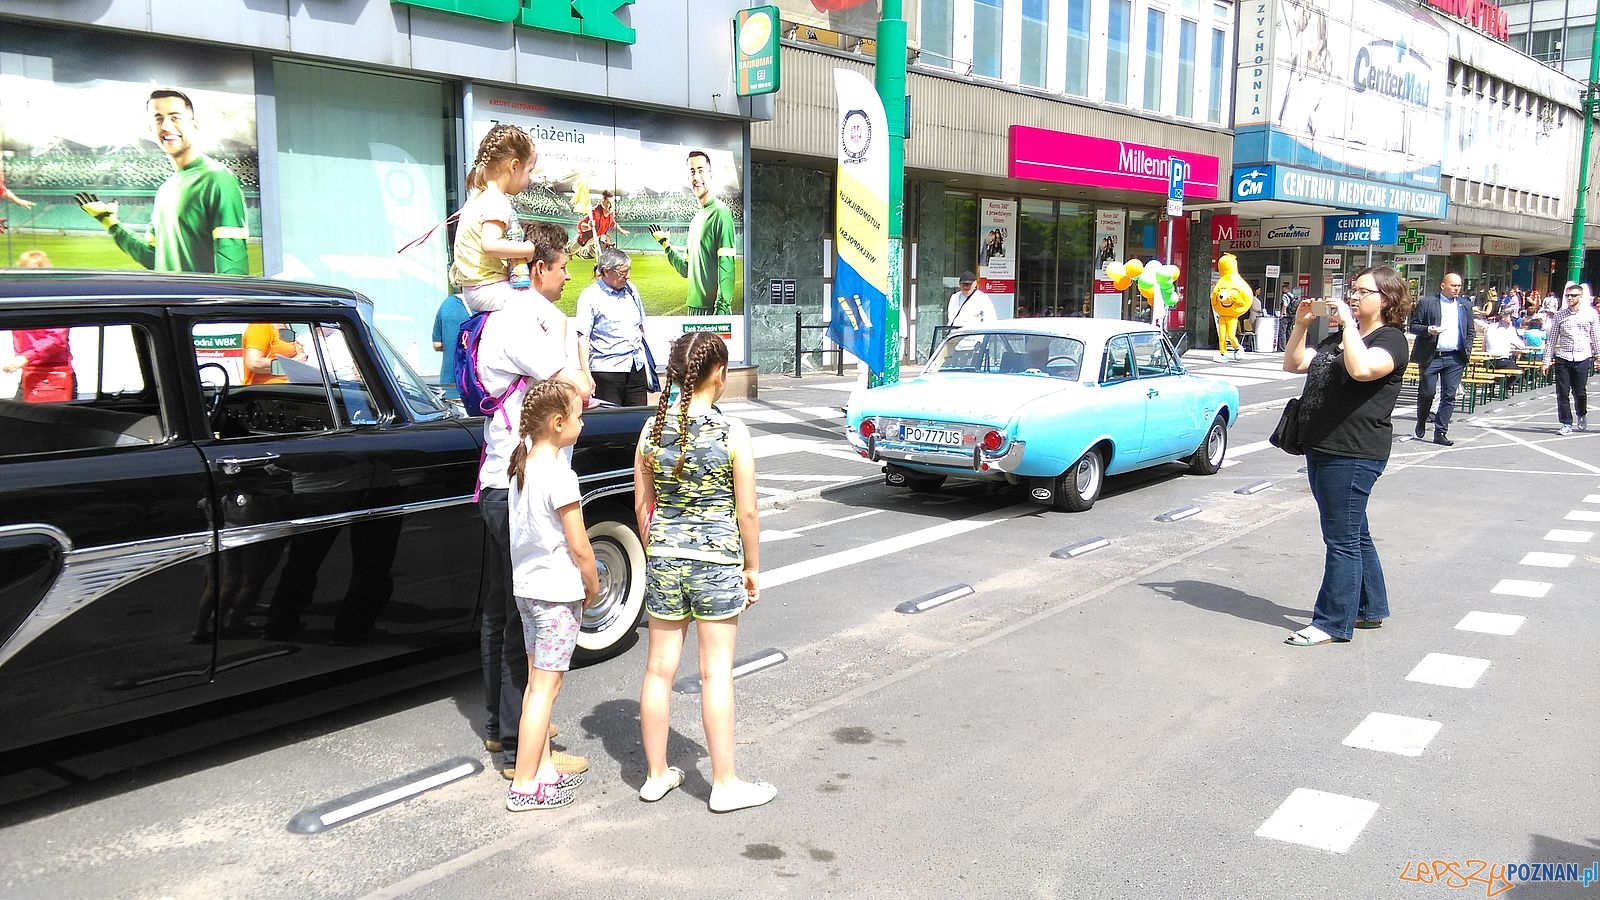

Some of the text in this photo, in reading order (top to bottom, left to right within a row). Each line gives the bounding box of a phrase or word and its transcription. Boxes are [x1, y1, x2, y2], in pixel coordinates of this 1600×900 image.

[738, 56, 773, 70] BANKOMAT
[1252, 4, 1266, 116] ZYCHODNIA
[1353, 47, 1430, 107] CenterMed
[1118, 142, 1191, 180] Millennim
[1172, 162, 1183, 188] P
[1283, 171, 1442, 215] CENTRUM MEDYCZNE ZAPRASZAMY
[1338, 218, 1380, 228] CENTRUM
[1218, 224, 1233, 240] M
[1268, 230, 1310, 239] CenterMed
[1335, 231, 1381, 241] MEDYCZ
[193, 337, 237, 347] odni WBK
[906, 427, 960, 445] PO 777US
